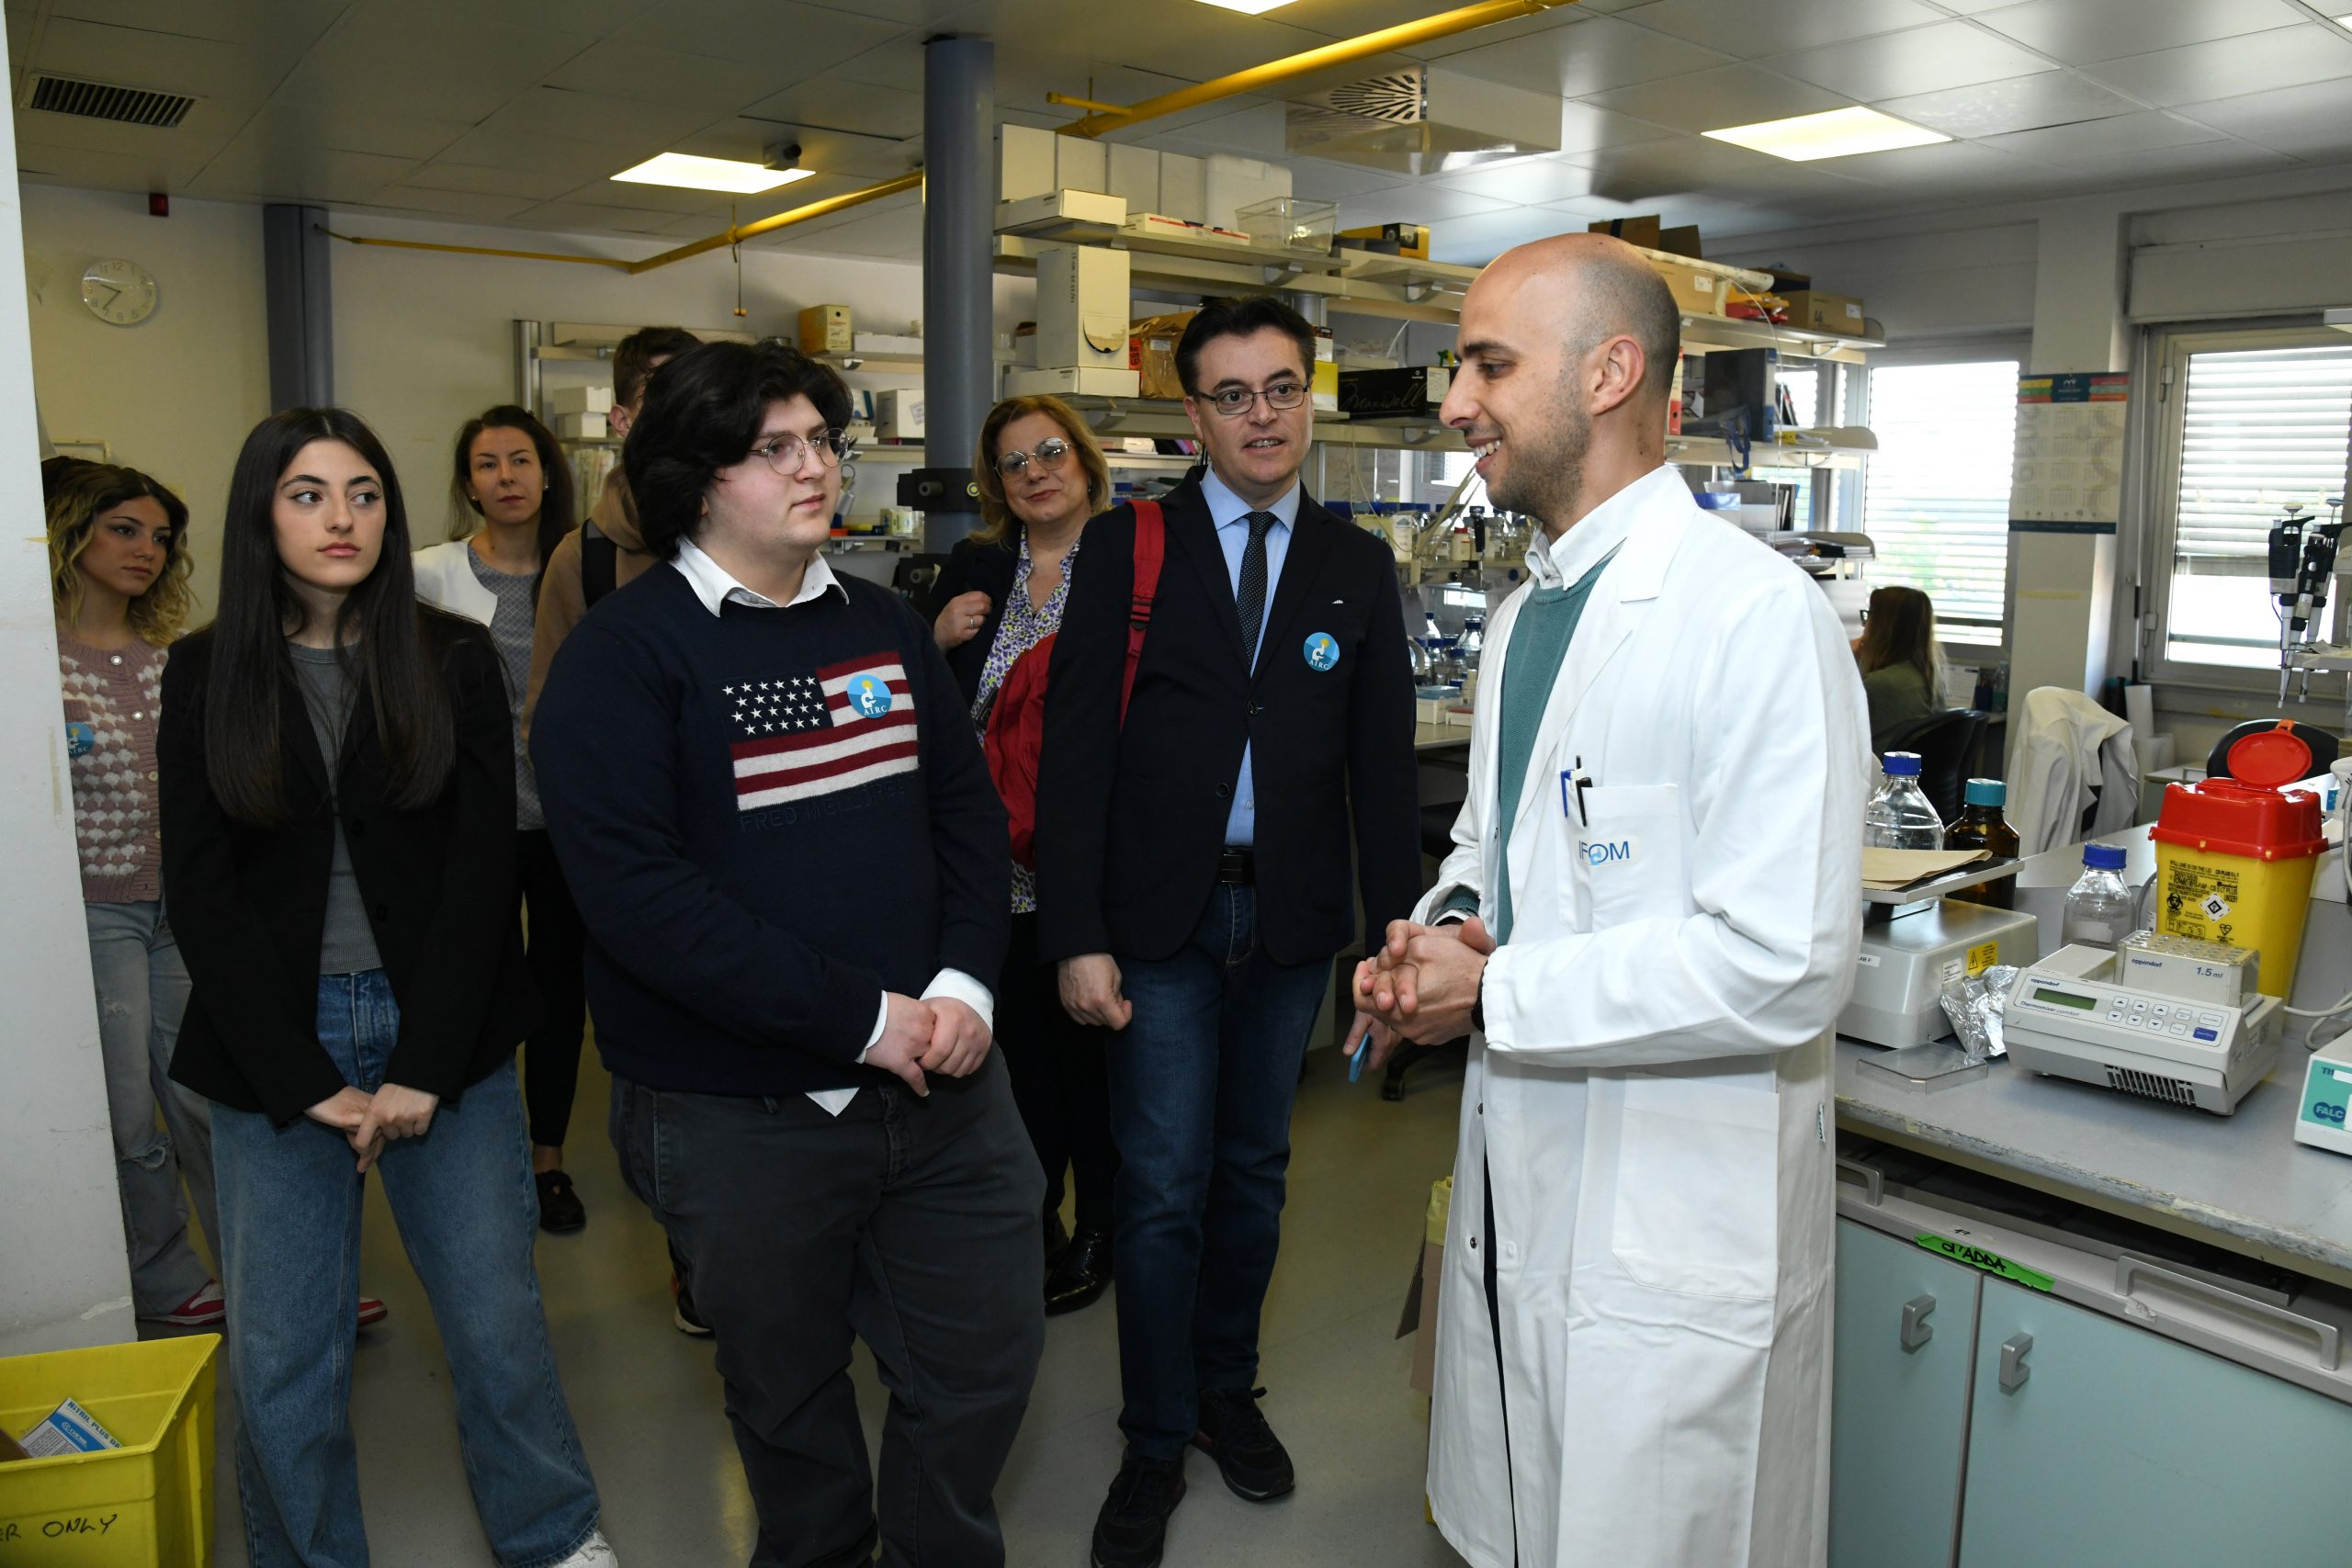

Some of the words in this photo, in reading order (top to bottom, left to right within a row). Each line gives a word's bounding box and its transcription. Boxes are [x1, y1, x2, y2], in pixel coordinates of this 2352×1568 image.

[112, 262, 123, 271] 12
[1308, 659, 1329, 671] AIRC
[864, 705, 888, 716] AIRC
[740, 807, 798, 833] FRED
[2132, 958, 2163, 968] eppendorf
[2196, 966, 2212, 976] 1.5
[2030, 978, 2061, 987] eppendorf
[2315, 1105, 2344, 1119] FALC
[91, 1421, 110, 1439] PLUS
[42, 1513, 118, 1538] ONLY
